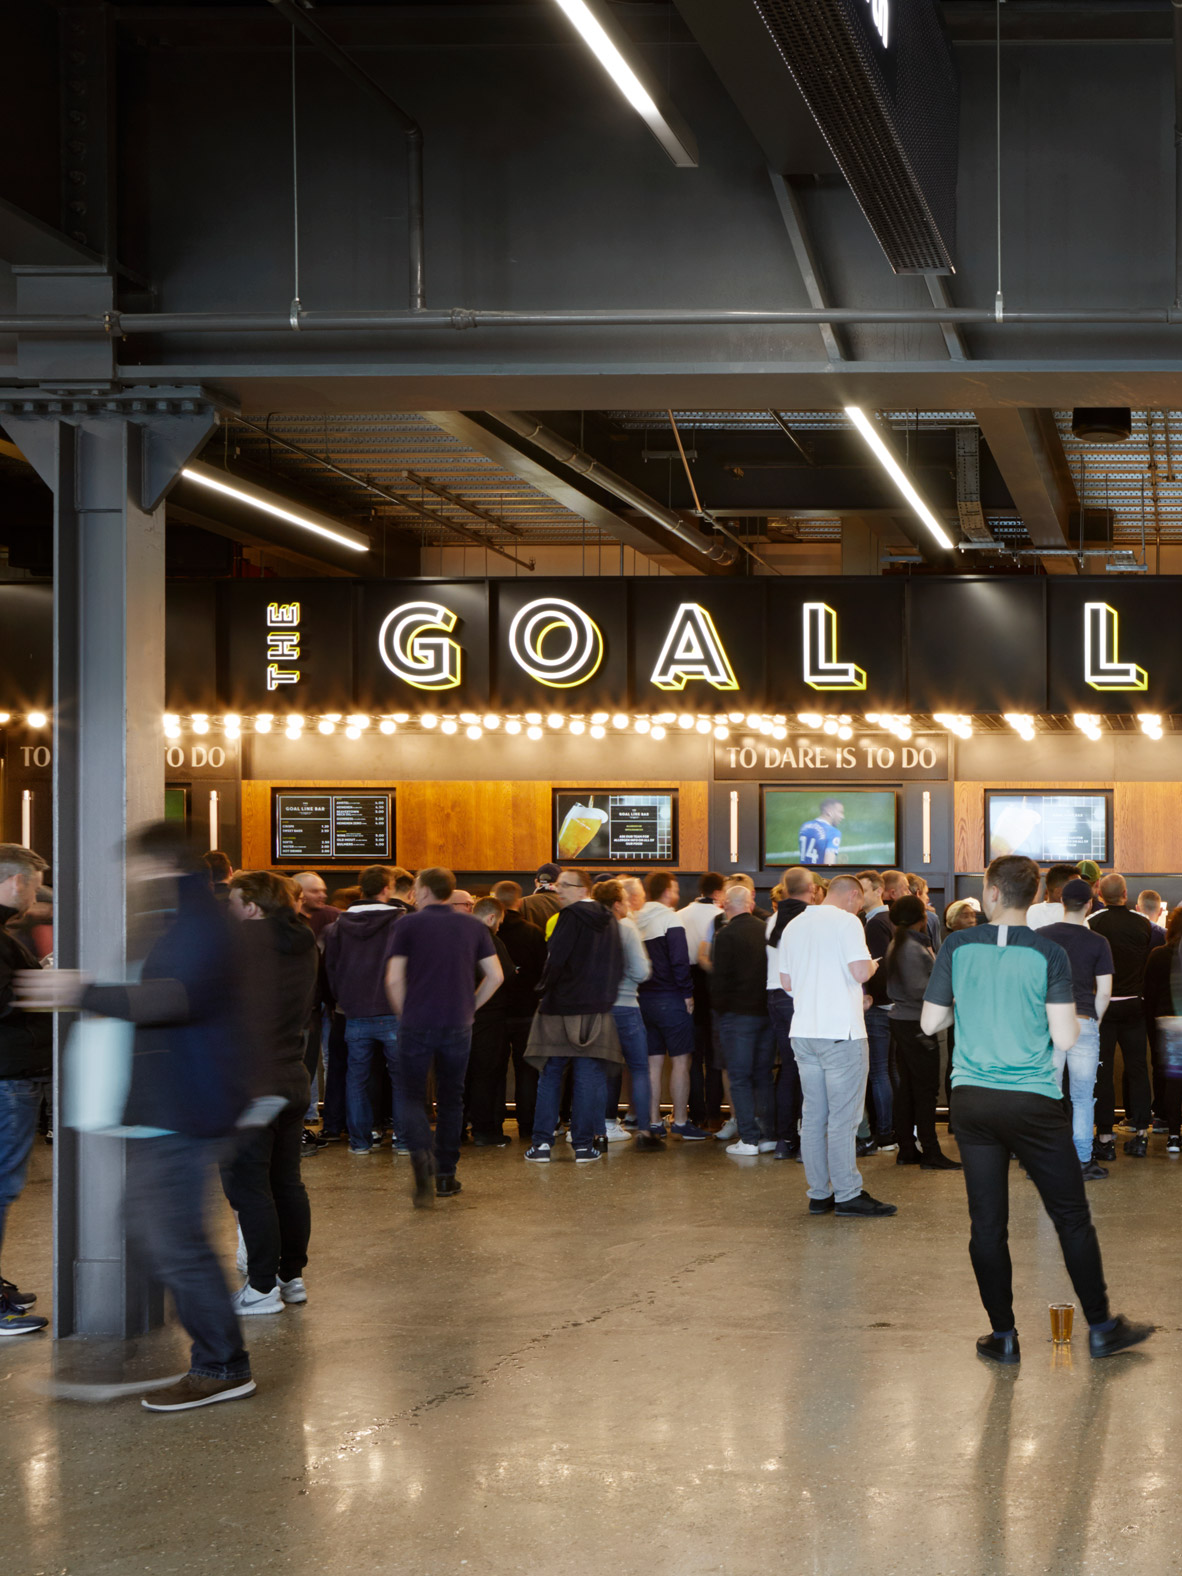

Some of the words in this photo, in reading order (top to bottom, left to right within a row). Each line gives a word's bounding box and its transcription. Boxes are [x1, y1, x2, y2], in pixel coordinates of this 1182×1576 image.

[267, 602, 300, 691] THE
[378, 597, 867, 691] GOAL
[20, 746, 51, 768] TO
[165, 746, 185, 768] O
[191, 746, 226, 768] DO
[726, 747, 758, 769] TO
[764, 747, 829, 769] DARE
[836, 747, 857, 769] IS
[863, 747, 895, 769] TO
[901, 747, 937, 769] DO
[799, 835, 819, 864] 14
